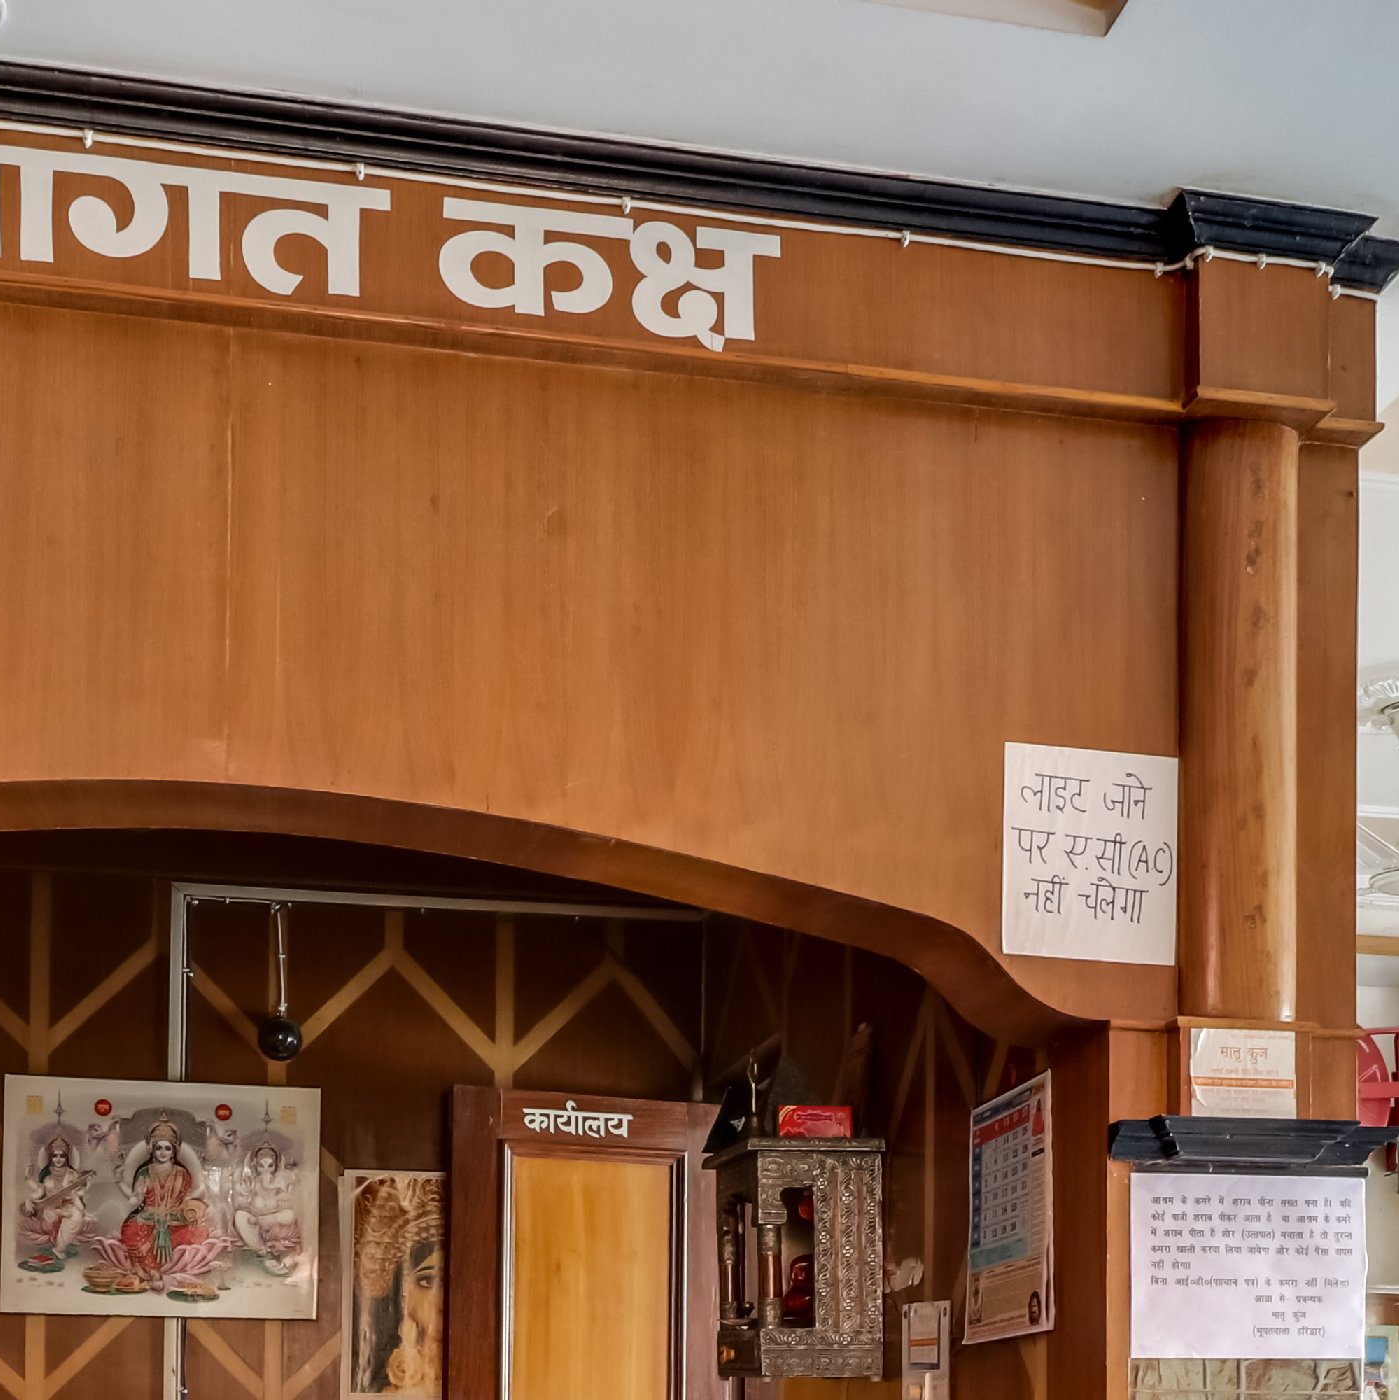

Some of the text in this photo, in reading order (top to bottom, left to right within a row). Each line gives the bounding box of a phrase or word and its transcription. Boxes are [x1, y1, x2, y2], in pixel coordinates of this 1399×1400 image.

[438, 196, 781, 352] कक्ष
[1020, 773, 1152, 820] लाइट जाने
[1011, 826, 1056, 865] पर
[1078, 877, 1149, 924] चलेगा
[522, 1100, 634, 1139] कार्यालय
